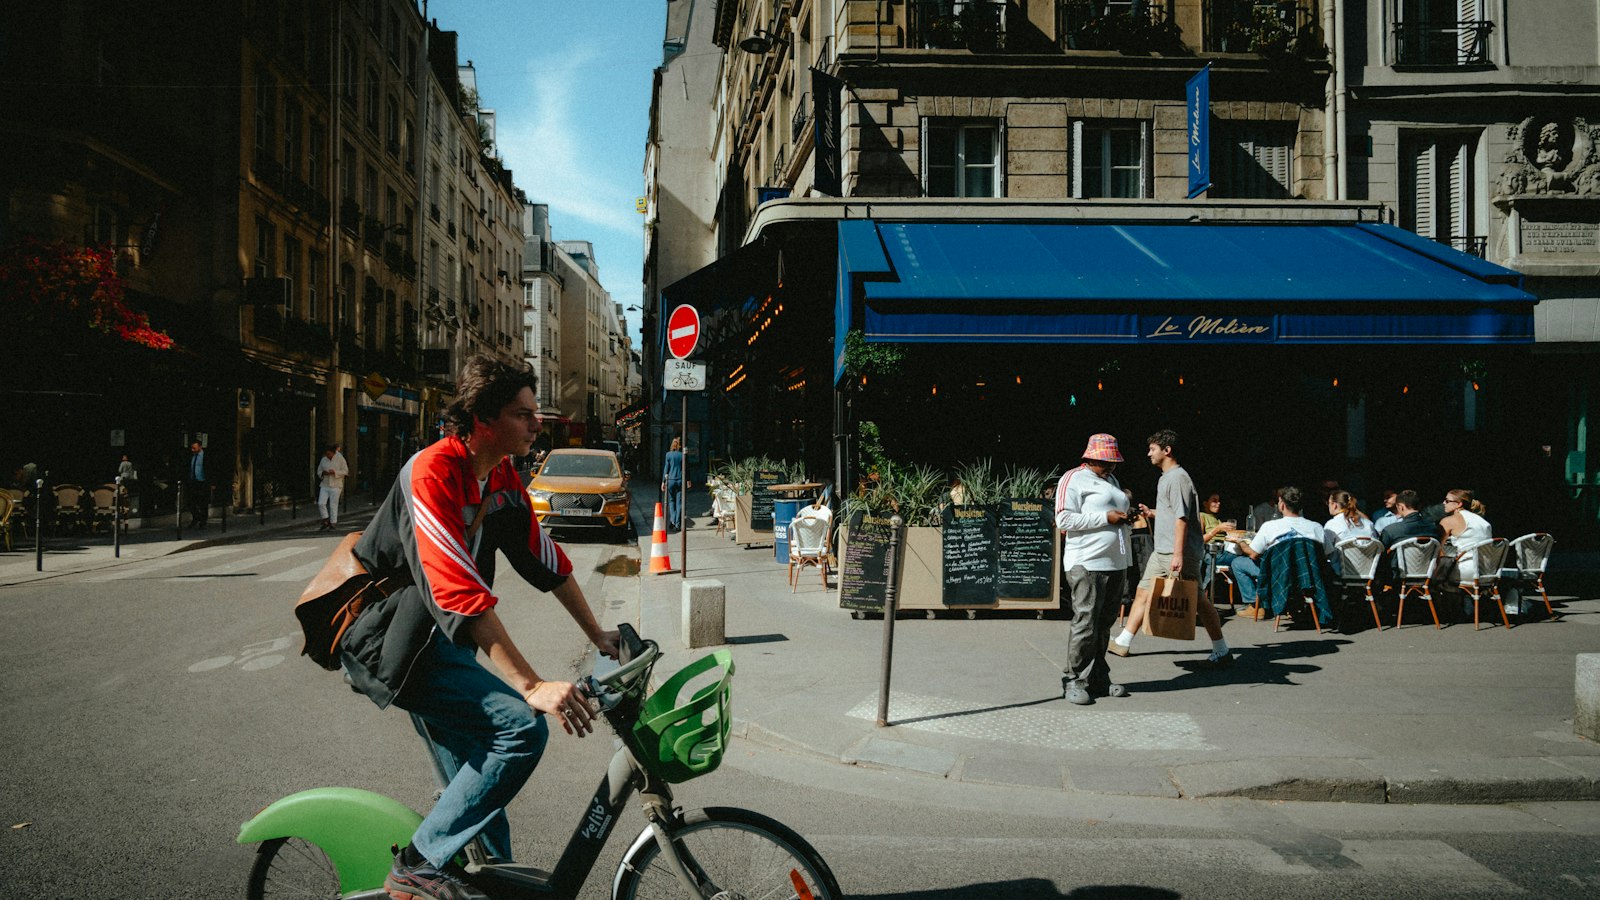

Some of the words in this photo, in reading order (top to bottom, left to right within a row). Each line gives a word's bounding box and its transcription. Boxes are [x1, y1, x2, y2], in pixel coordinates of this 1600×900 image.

[1146, 316, 1182, 338] Le
[1188, 315, 1269, 339] Molière
[675, 361, 697, 370] SAUF
[1011, 501, 1043, 512] Warsteiner
[1158, 596, 1189, 612] MUJI
